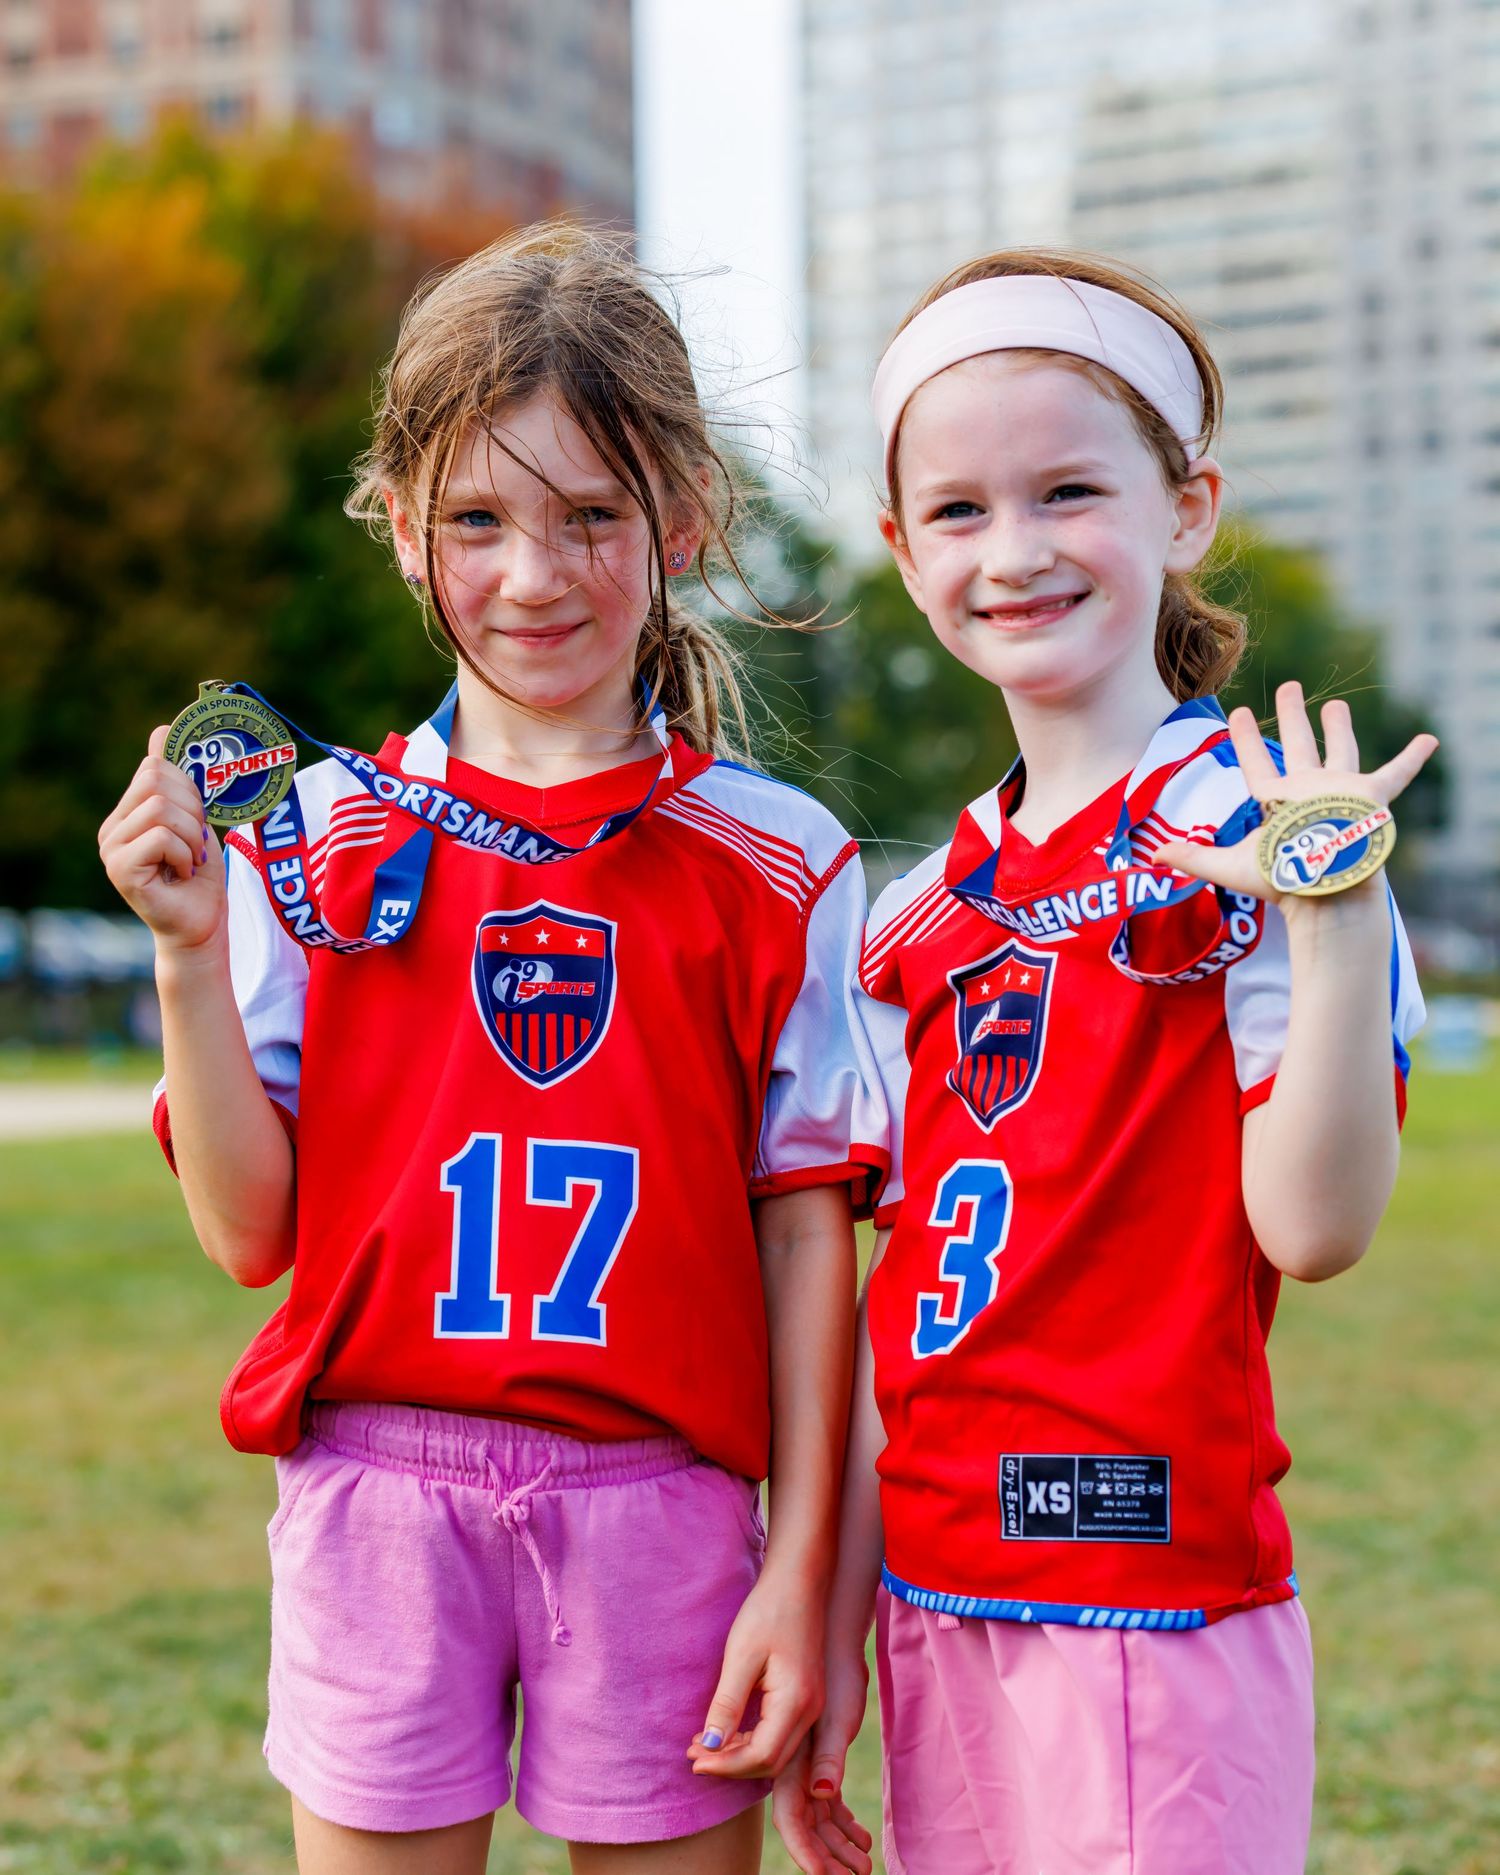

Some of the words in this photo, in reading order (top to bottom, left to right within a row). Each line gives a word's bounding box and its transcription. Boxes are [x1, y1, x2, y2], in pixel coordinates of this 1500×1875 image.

[166, 710, 197, 761] XCELLENCE
[197, 704, 209, 715] IN
[210, 698, 287, 740] SPORTSMANSHIP
[206, 744, 296, 790] SPORTS
[264, 800, 298, 850] IN
[1279, 814, 1290, 823] IN
[1290, 796, 1376, 815] SPORTSMANSHIP
[1305, 810, 1388, 866] SPORTS
[1125, 872, 1174, 907] IN
[517, 981, 596, 998] SPORTS
[433, 1132, 640, 1347] 17
[911, 1158, 1014, 1360] 3
[1112, 1472, 1146, 1481] Spandex
[1113, 1463, 1150, 1472] Polyester
[1003, 1460, 1020, 1535] dry-Excel
[1026, 1481, 1071, 1514] XS
